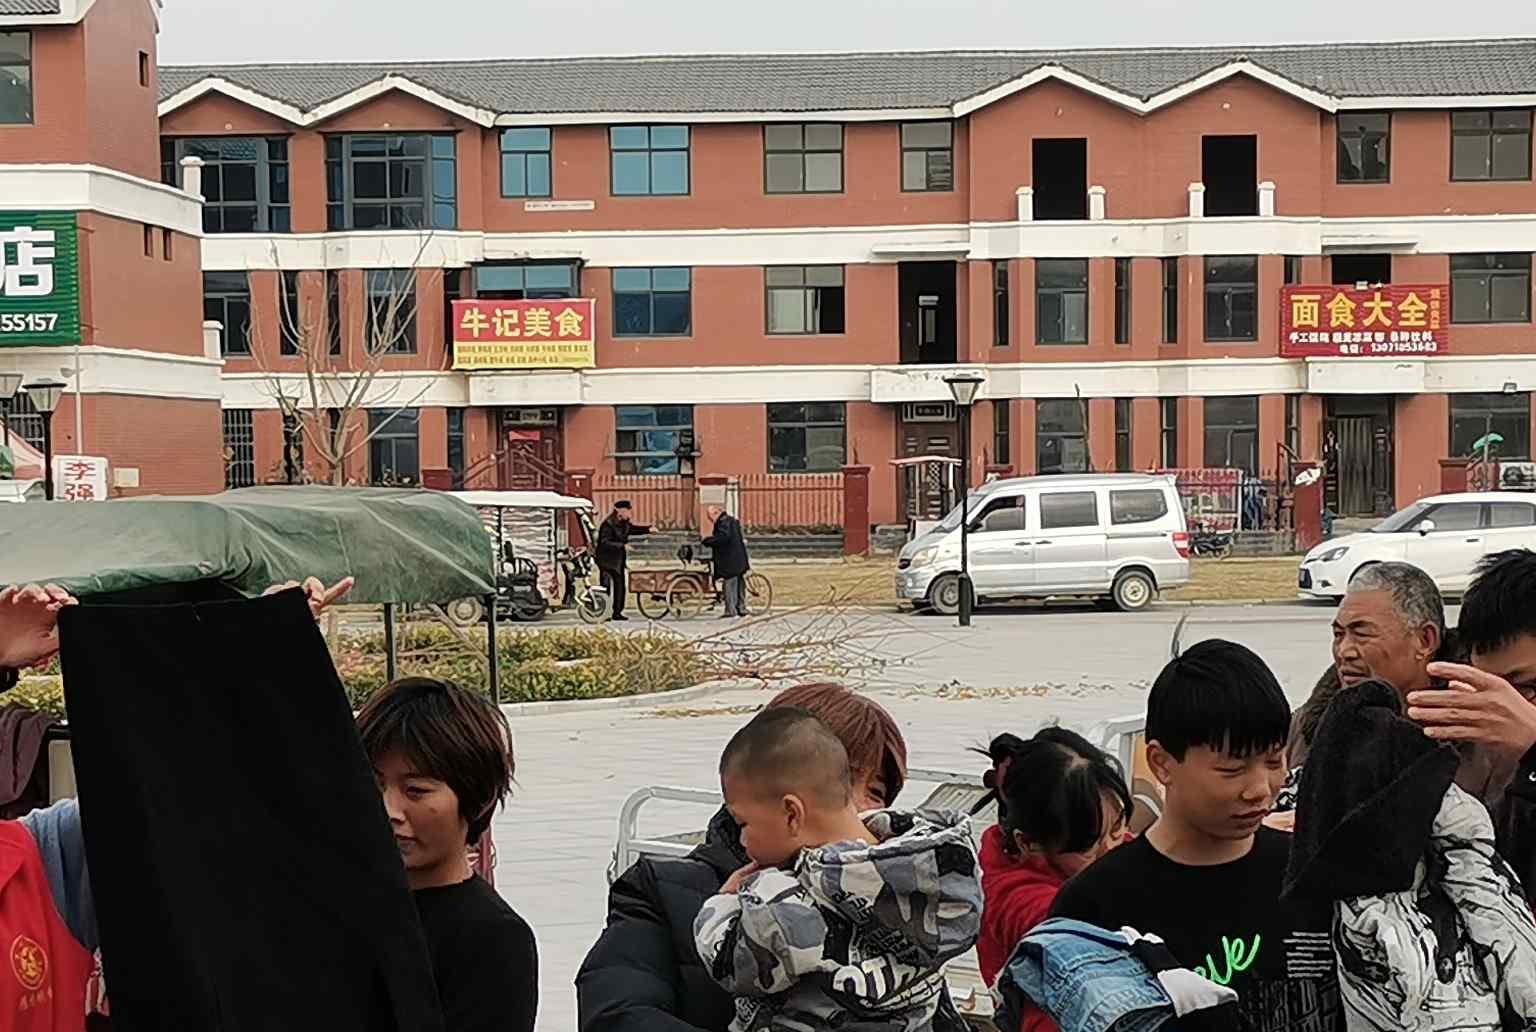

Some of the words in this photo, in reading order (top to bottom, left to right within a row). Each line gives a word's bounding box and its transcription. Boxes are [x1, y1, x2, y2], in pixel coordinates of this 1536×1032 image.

[460, 307, 584, 337] 牛记美食
[1290, 292, 1428, 328] 面食大全
